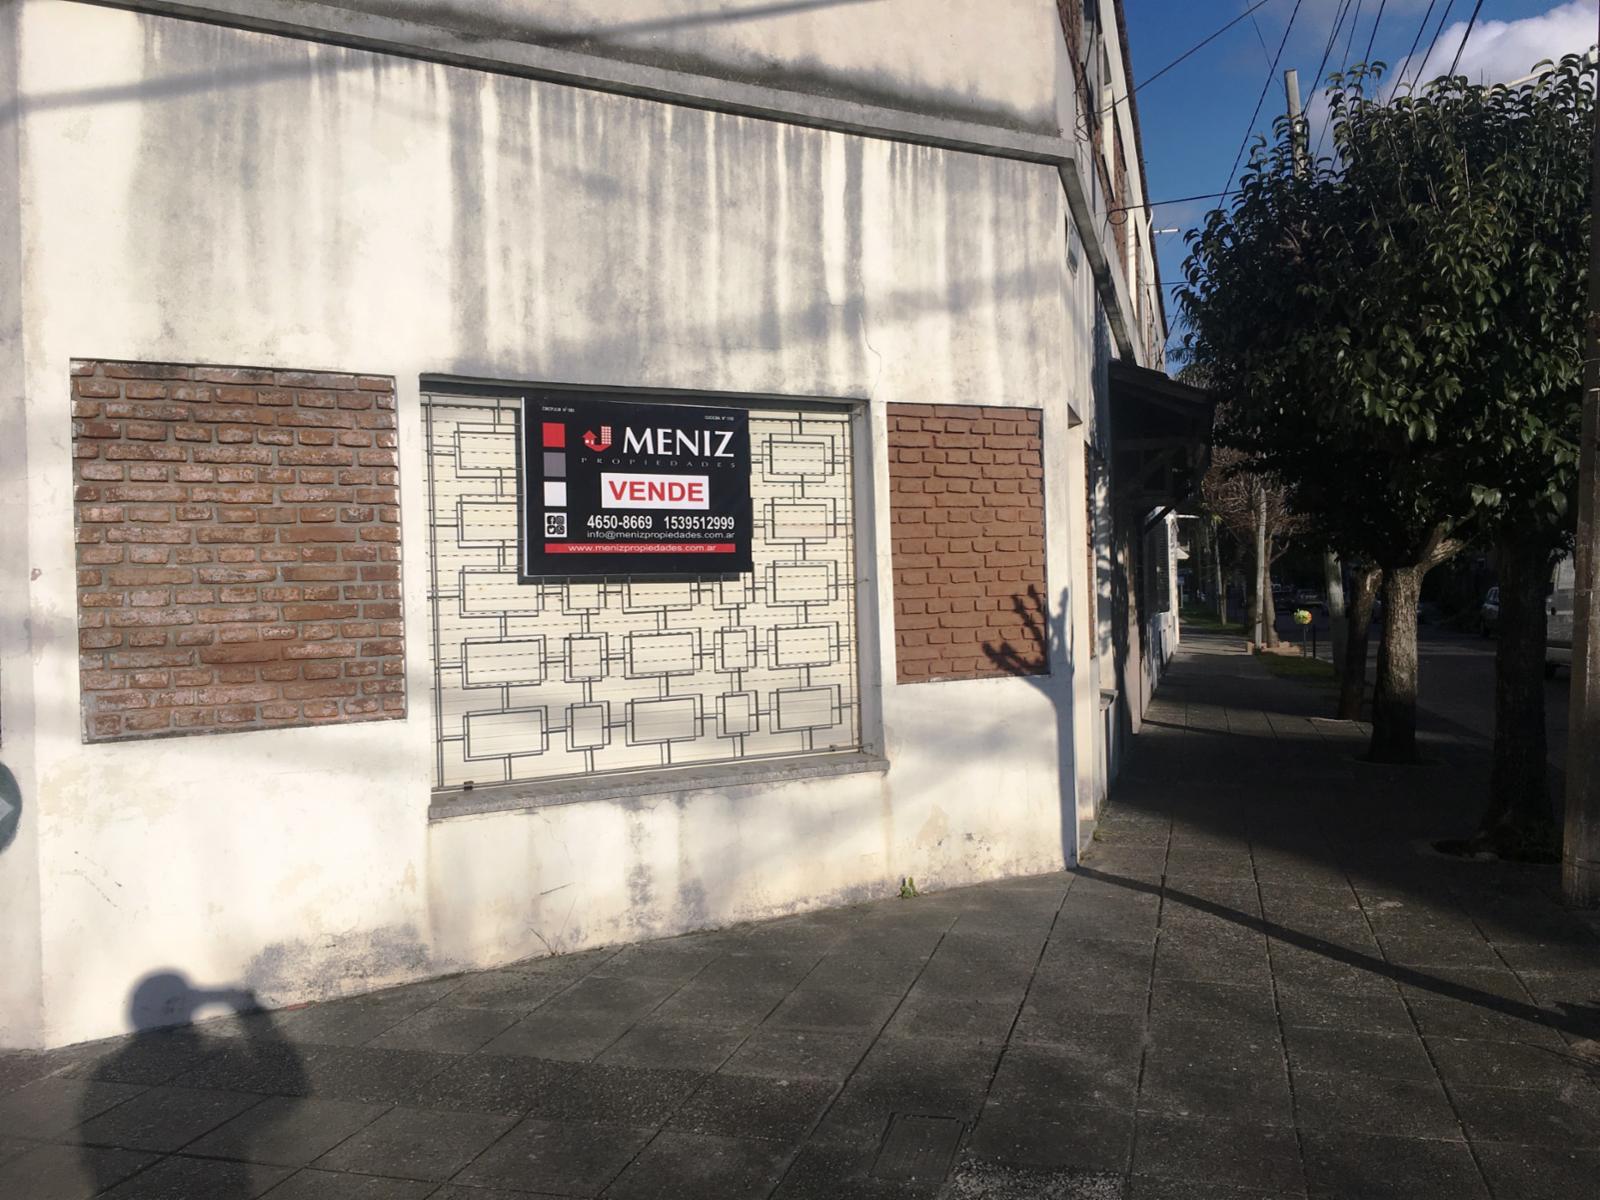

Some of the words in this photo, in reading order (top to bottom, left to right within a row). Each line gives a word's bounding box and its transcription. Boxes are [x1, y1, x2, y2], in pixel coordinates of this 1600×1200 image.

[623, 426, 734, 457] MENIZ
[581, 457, 736, 468] PROPIEDADES
[608, 480, 704, 502] VENDE
[587, 515, 653, 529] 4650-8669
[663, 516, 735, 530] 1539512999
[587, 531, 735, 540] info@menizpropiedades.com.ar
[568, 544, 716, 553] www.menizpropiedades.com.ar
